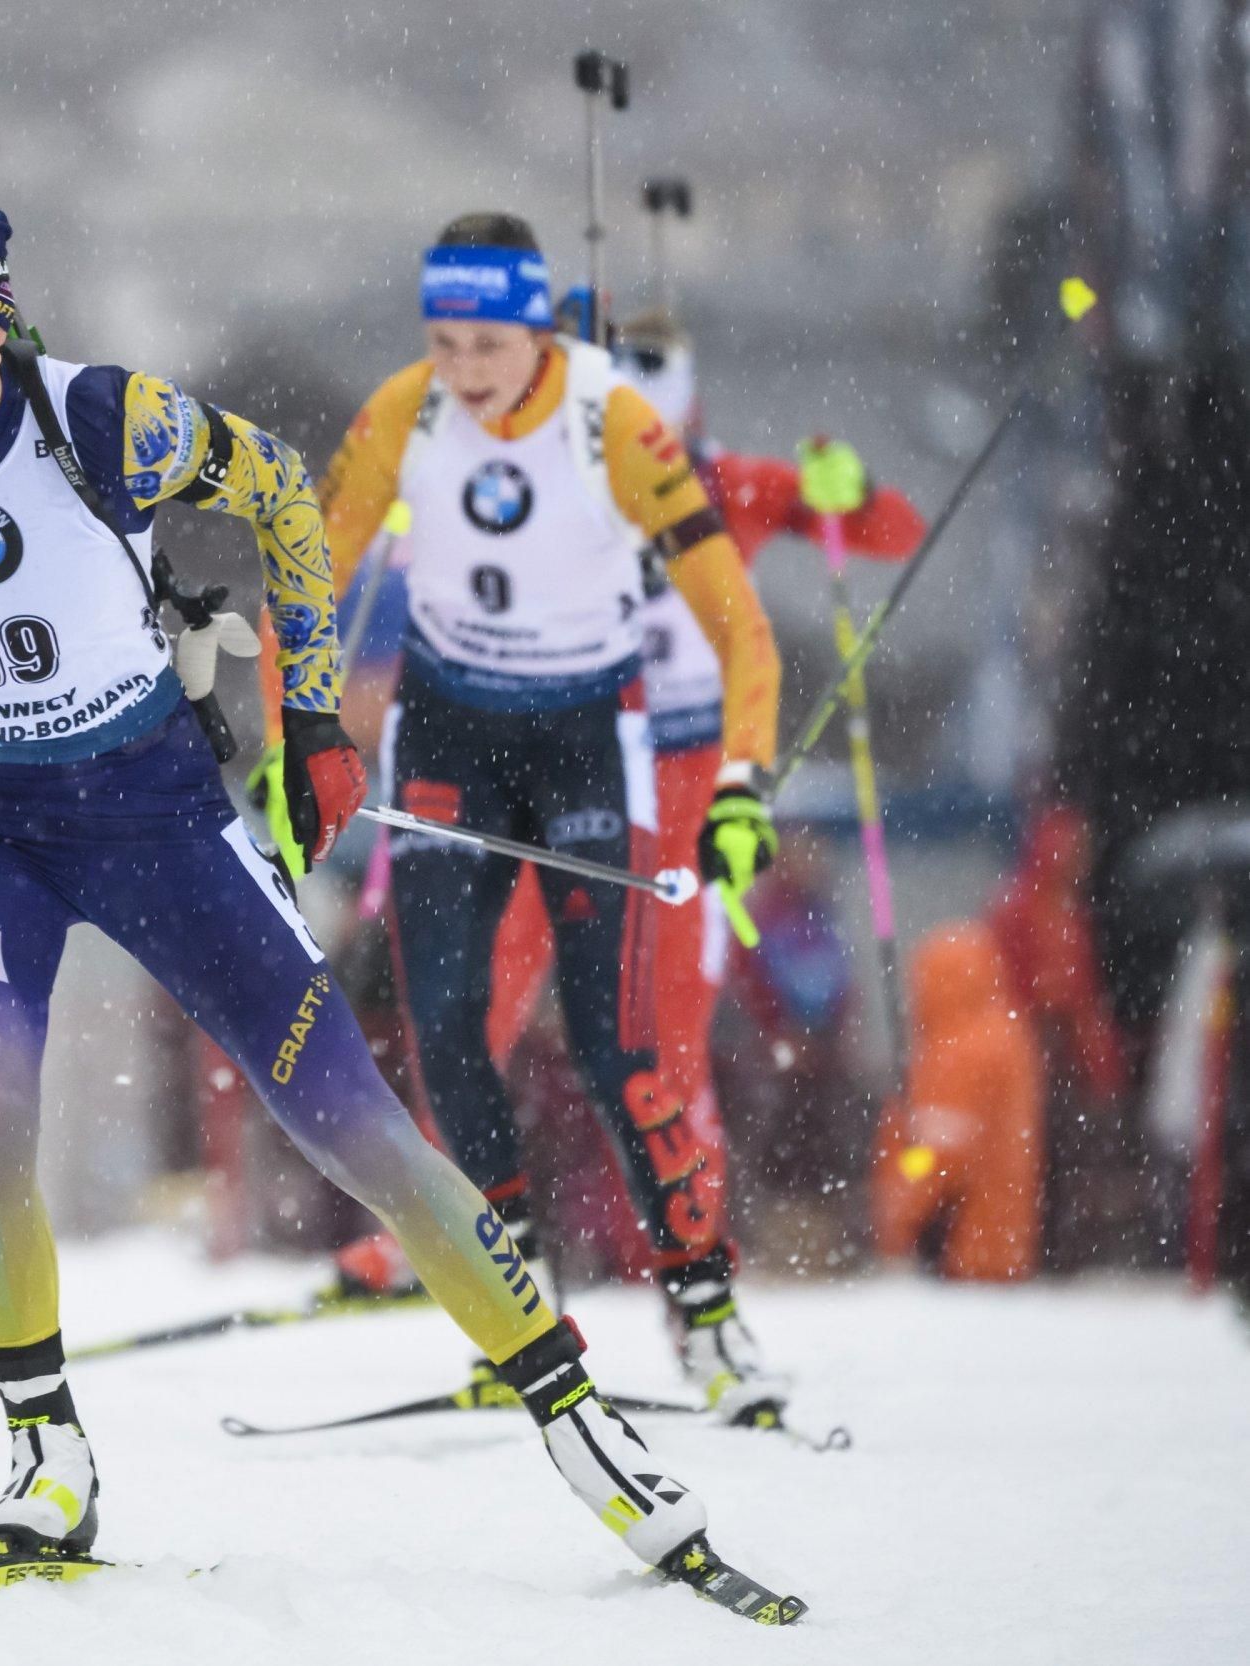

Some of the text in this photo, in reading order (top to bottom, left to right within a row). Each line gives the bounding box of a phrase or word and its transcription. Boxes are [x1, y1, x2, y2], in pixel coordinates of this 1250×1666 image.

[469, 564, 512, 615] 9
[272, 987, 323, 1085] CRAFT
[475, 1202, 540, 1316] UKR
[7, 1415, 50, 1428] CHER
